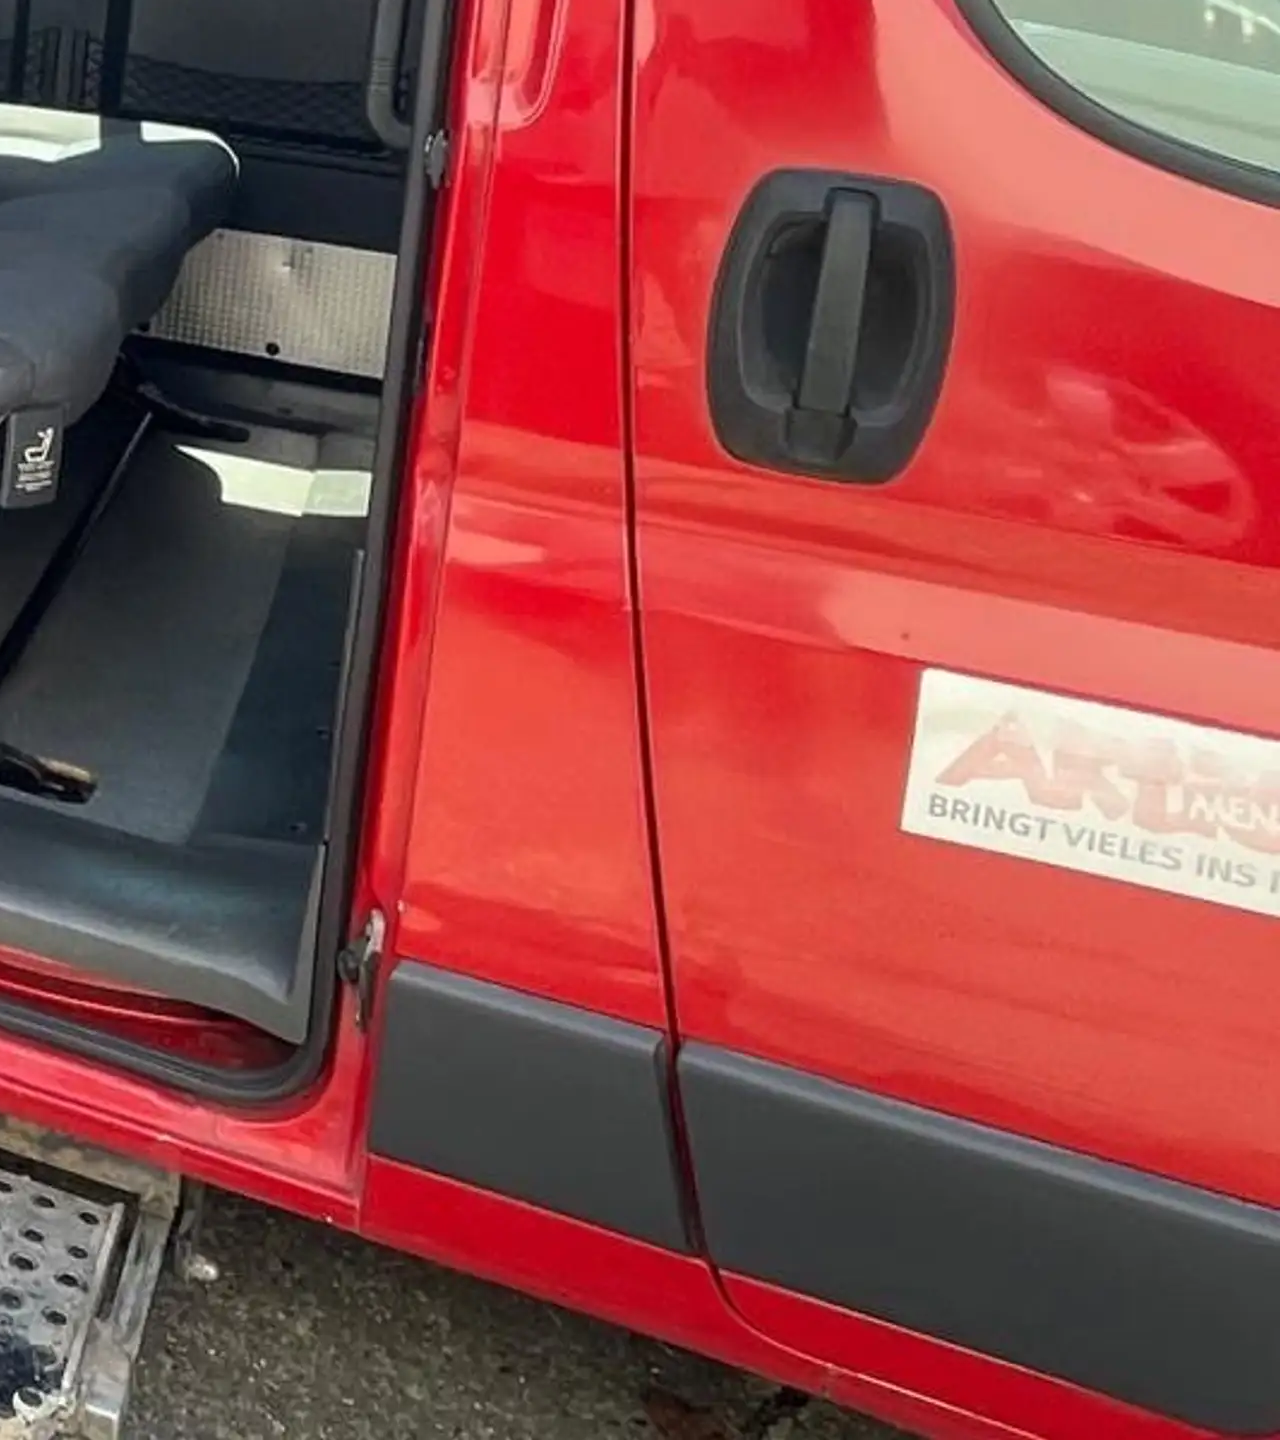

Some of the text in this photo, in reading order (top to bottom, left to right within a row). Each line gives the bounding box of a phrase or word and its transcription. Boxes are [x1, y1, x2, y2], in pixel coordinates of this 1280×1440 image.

[928, 793, 1057, 842] BRINGT
[1060, 822, 1183, 871] VIELES
[1194, 852, 1257, 889] INS
